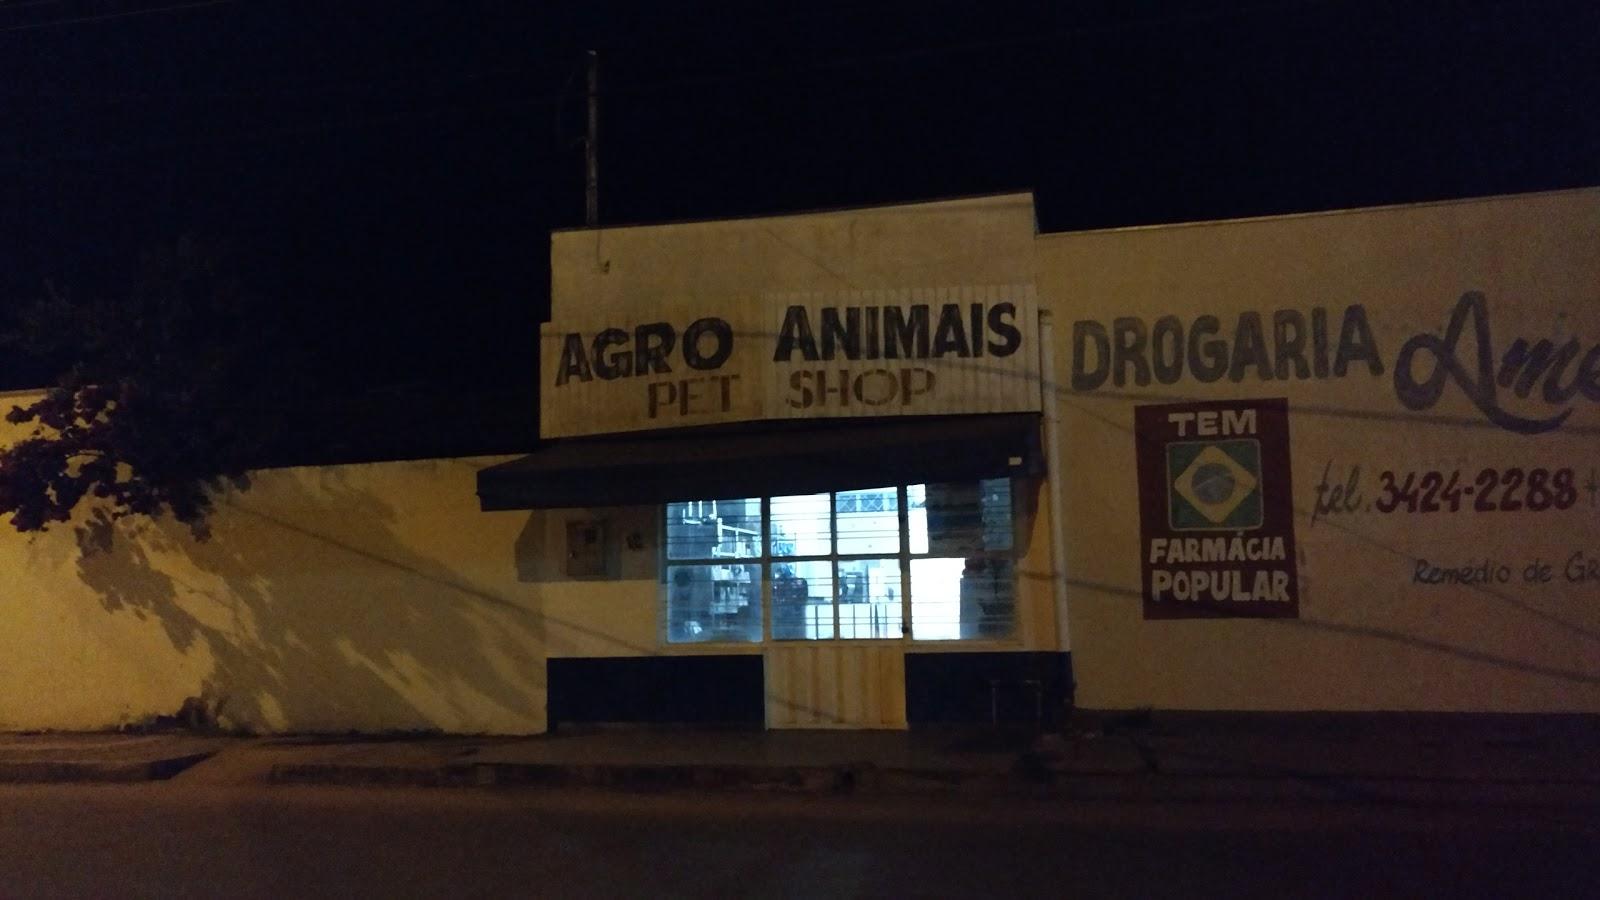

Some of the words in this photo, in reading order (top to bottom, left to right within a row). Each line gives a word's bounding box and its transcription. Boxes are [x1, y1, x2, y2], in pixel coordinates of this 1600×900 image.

[556, 317, 734, 387] AGRO
[773, 303, 1022, 362] ANIMAIS
[1071, 304, 1385, 391] DROGARIA
[648, 375, 740, 419] PET
[785, 367, 936, 410] SHOP
[1168, 409, 1256, 437] TEM
[1375, 468, 1577, 514] 3424-2288
[1150, 530, 1286, 564] FARMÁCIA
[1152, 569, 1290, 602] POPULAR
[1523, 557, 1552, 583] de
